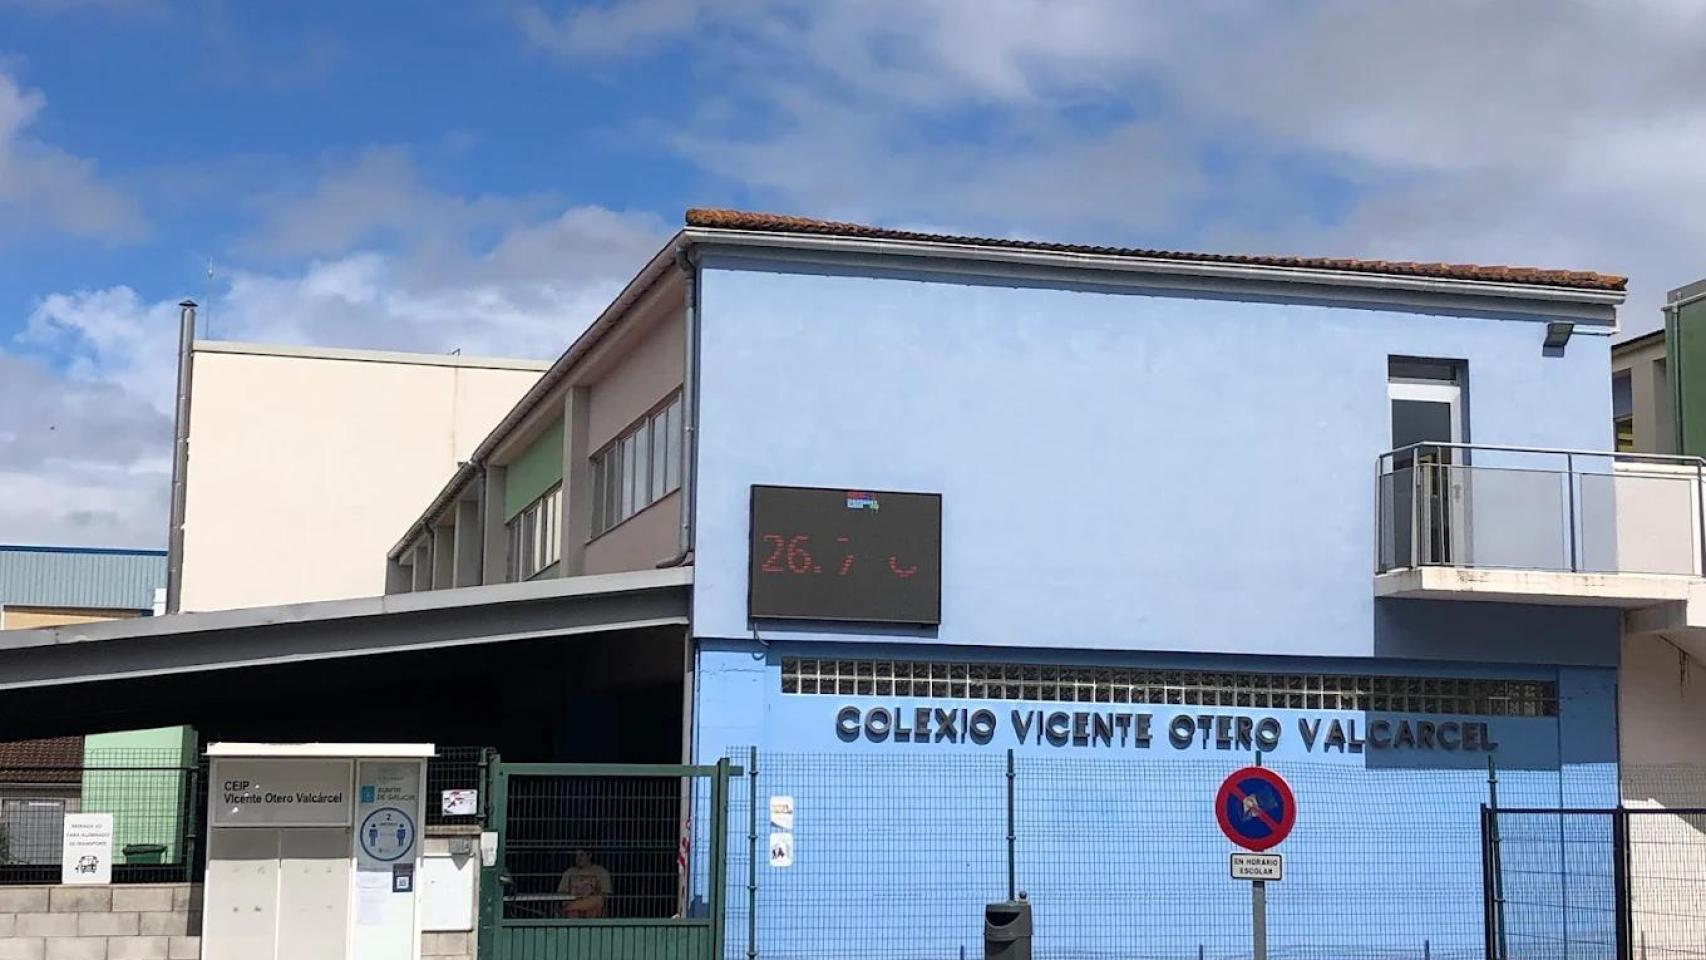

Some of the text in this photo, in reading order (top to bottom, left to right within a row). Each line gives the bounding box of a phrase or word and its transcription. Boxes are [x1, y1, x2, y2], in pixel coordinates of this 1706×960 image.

[836, 706, 1498, 752] COLEXIO VICENTE OTERO VALCARCEL
[224, 781, 250, 791] CEIP
[224, 792, 342, 804] Vicente Otero Valcárcel
[1234, 858, 1278, 867] EN HORARIO
